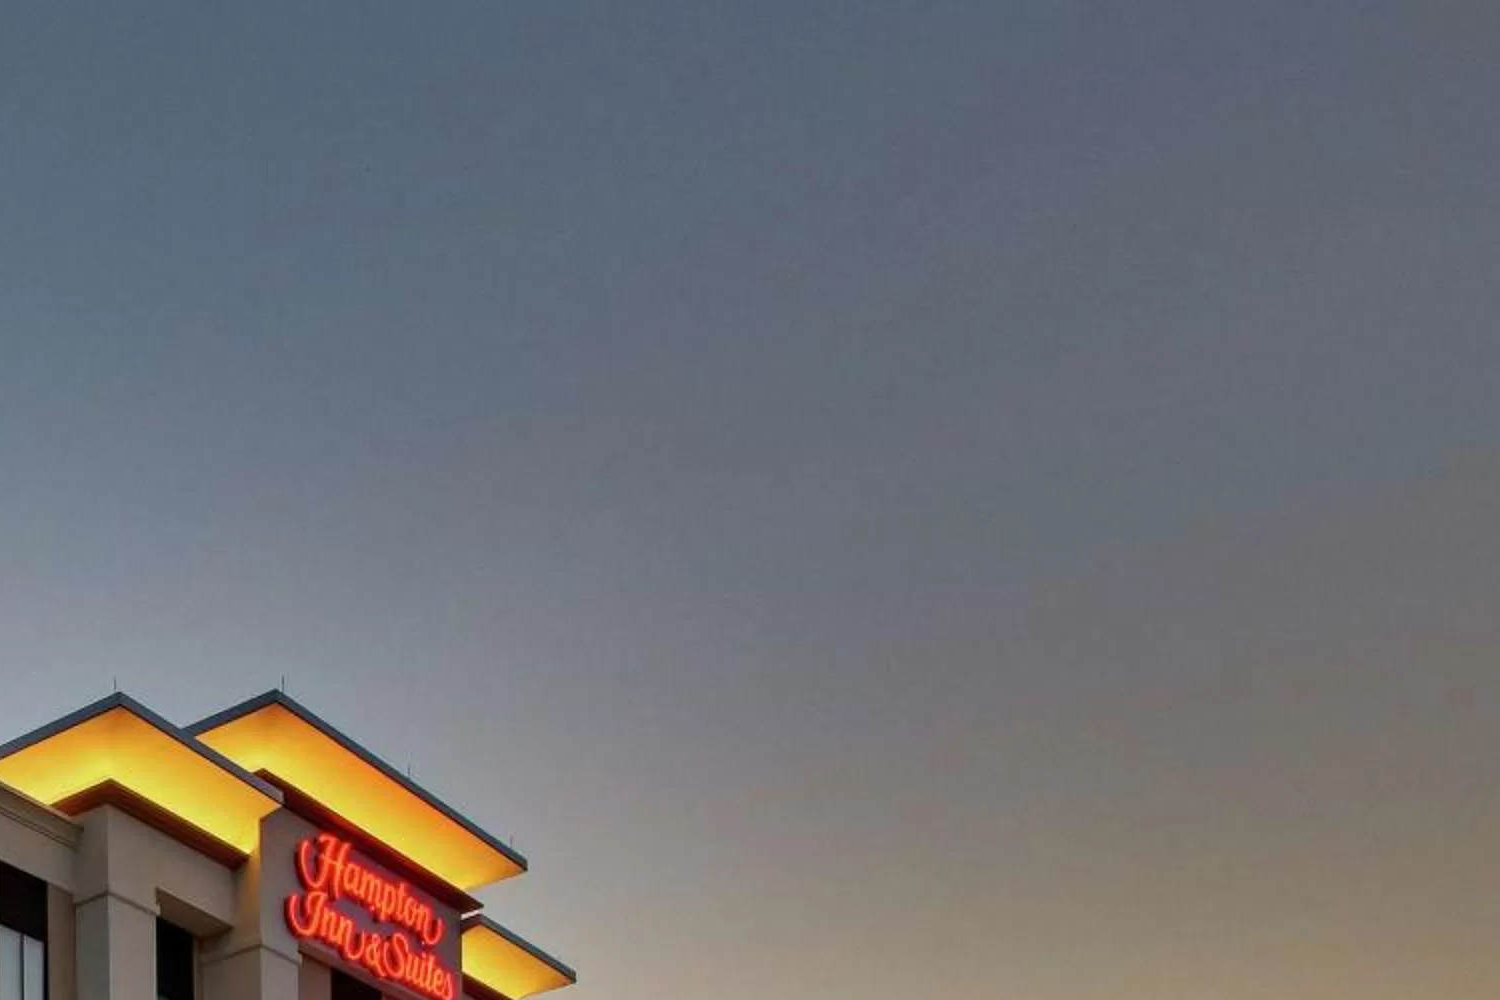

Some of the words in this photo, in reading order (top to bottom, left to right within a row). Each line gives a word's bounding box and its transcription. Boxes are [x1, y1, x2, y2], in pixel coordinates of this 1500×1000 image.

[288, 890, 365, 961] Inn
[364, 933, 387, 978] &
[299, 834, 444, 946] Hampton
